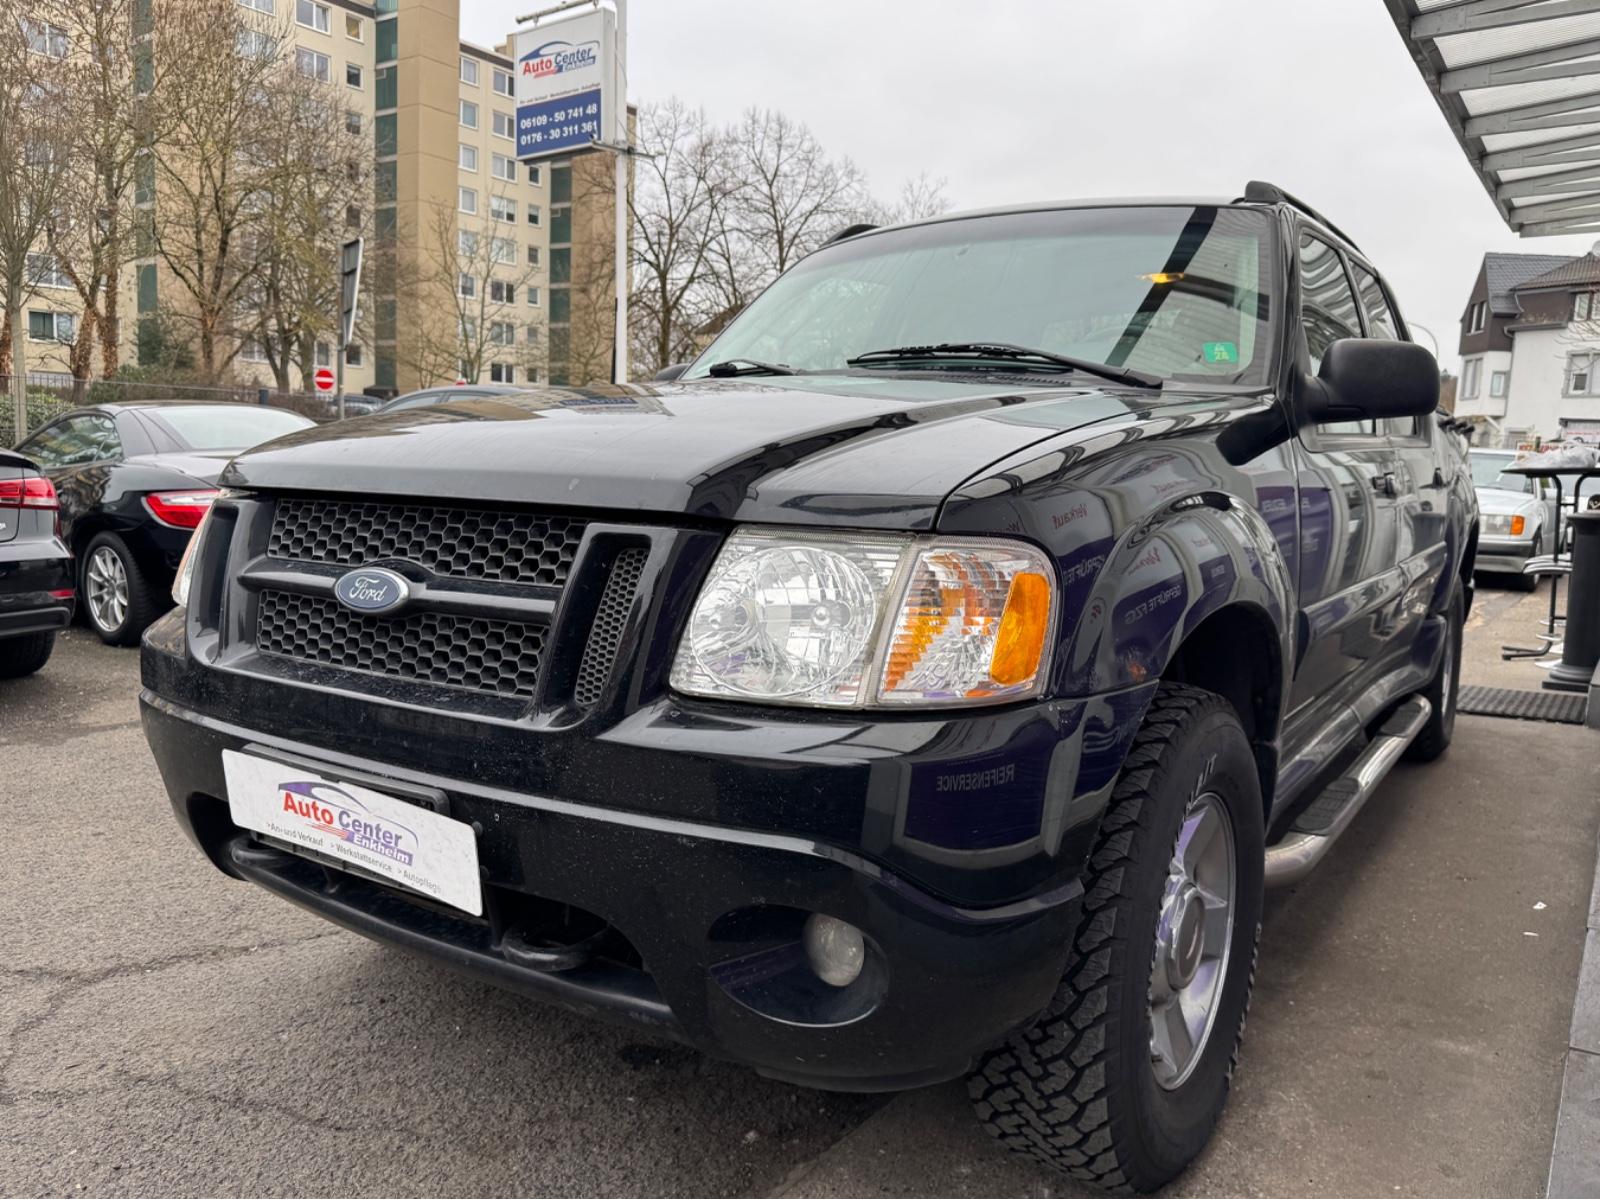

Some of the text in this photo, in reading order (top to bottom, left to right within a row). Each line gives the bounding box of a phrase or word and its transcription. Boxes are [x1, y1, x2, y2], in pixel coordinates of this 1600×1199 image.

[523, 57, 552, 75] Auto
[555, 47, 592, 65] Center
[520, 115, 547, 129] 06109
[554, 111, 565, 122] 50
[567, 106, 583, 120] 741
[585, 103, 597, 114] 48
[520, 132, 542, 145] 0176
[549, 128, 560, 140] 30
[562, 124, 578, 137] 311
[581, 120, 597, 133] 361
[349, 576, 388, 602] Ford
[283, 791, 402, 847] Auto Center
[353, 834, 411, 864] Enkheim
